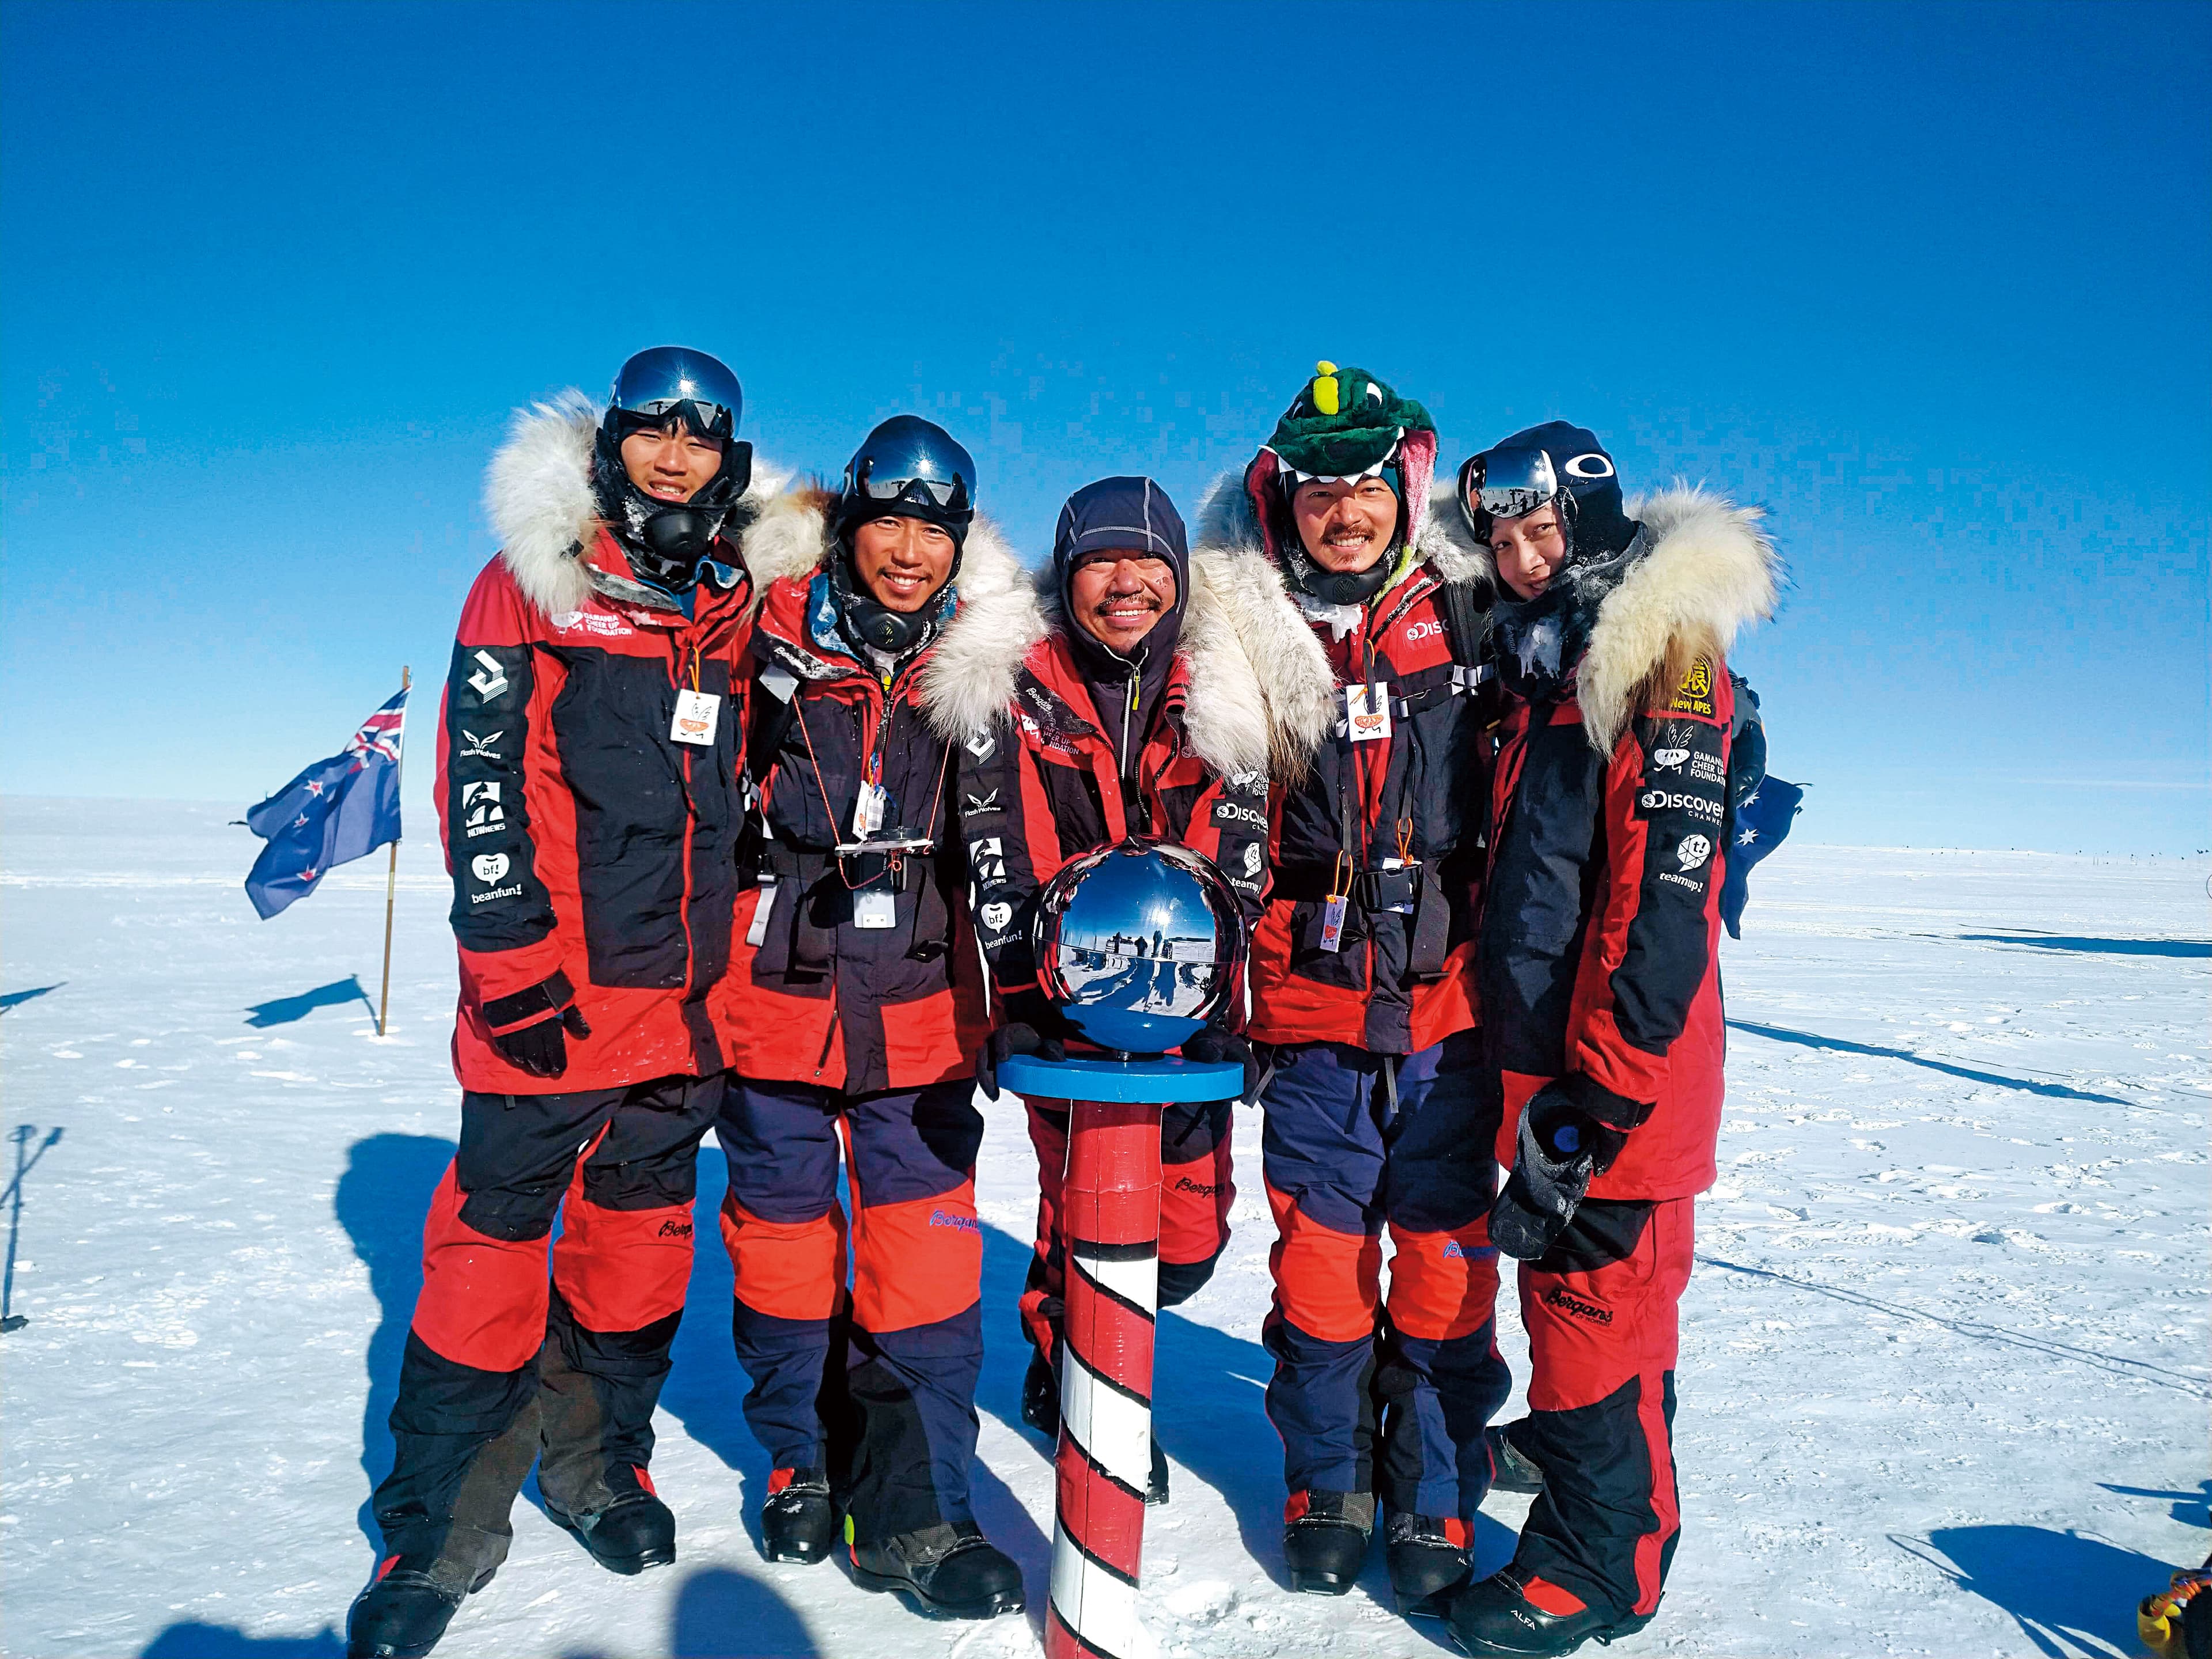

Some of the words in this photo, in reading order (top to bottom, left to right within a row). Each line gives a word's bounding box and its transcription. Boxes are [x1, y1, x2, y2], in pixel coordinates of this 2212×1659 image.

[1693, 700, 1711, 714] APES
[1061, 737, 1071, 745] UP
[475, 748, 501, 759] Wolves
[1692, 760, 1715, 773] CHEER
[965, 809, 978, 818] Flash
[1693, 841, 1706, 853] t!
[483, 864, 499, 876] bf!
[1659, 873, 1704, 893] teamup!
[471, 884, 522, 904] beanfun!
[988, 913, 1003, 924] bf!
[984, 930, 1022, 950] beanfun!
[1546, 1288, 1613, 1322] Bergans
[1510, 1610, 1536, 1631] ALFA
